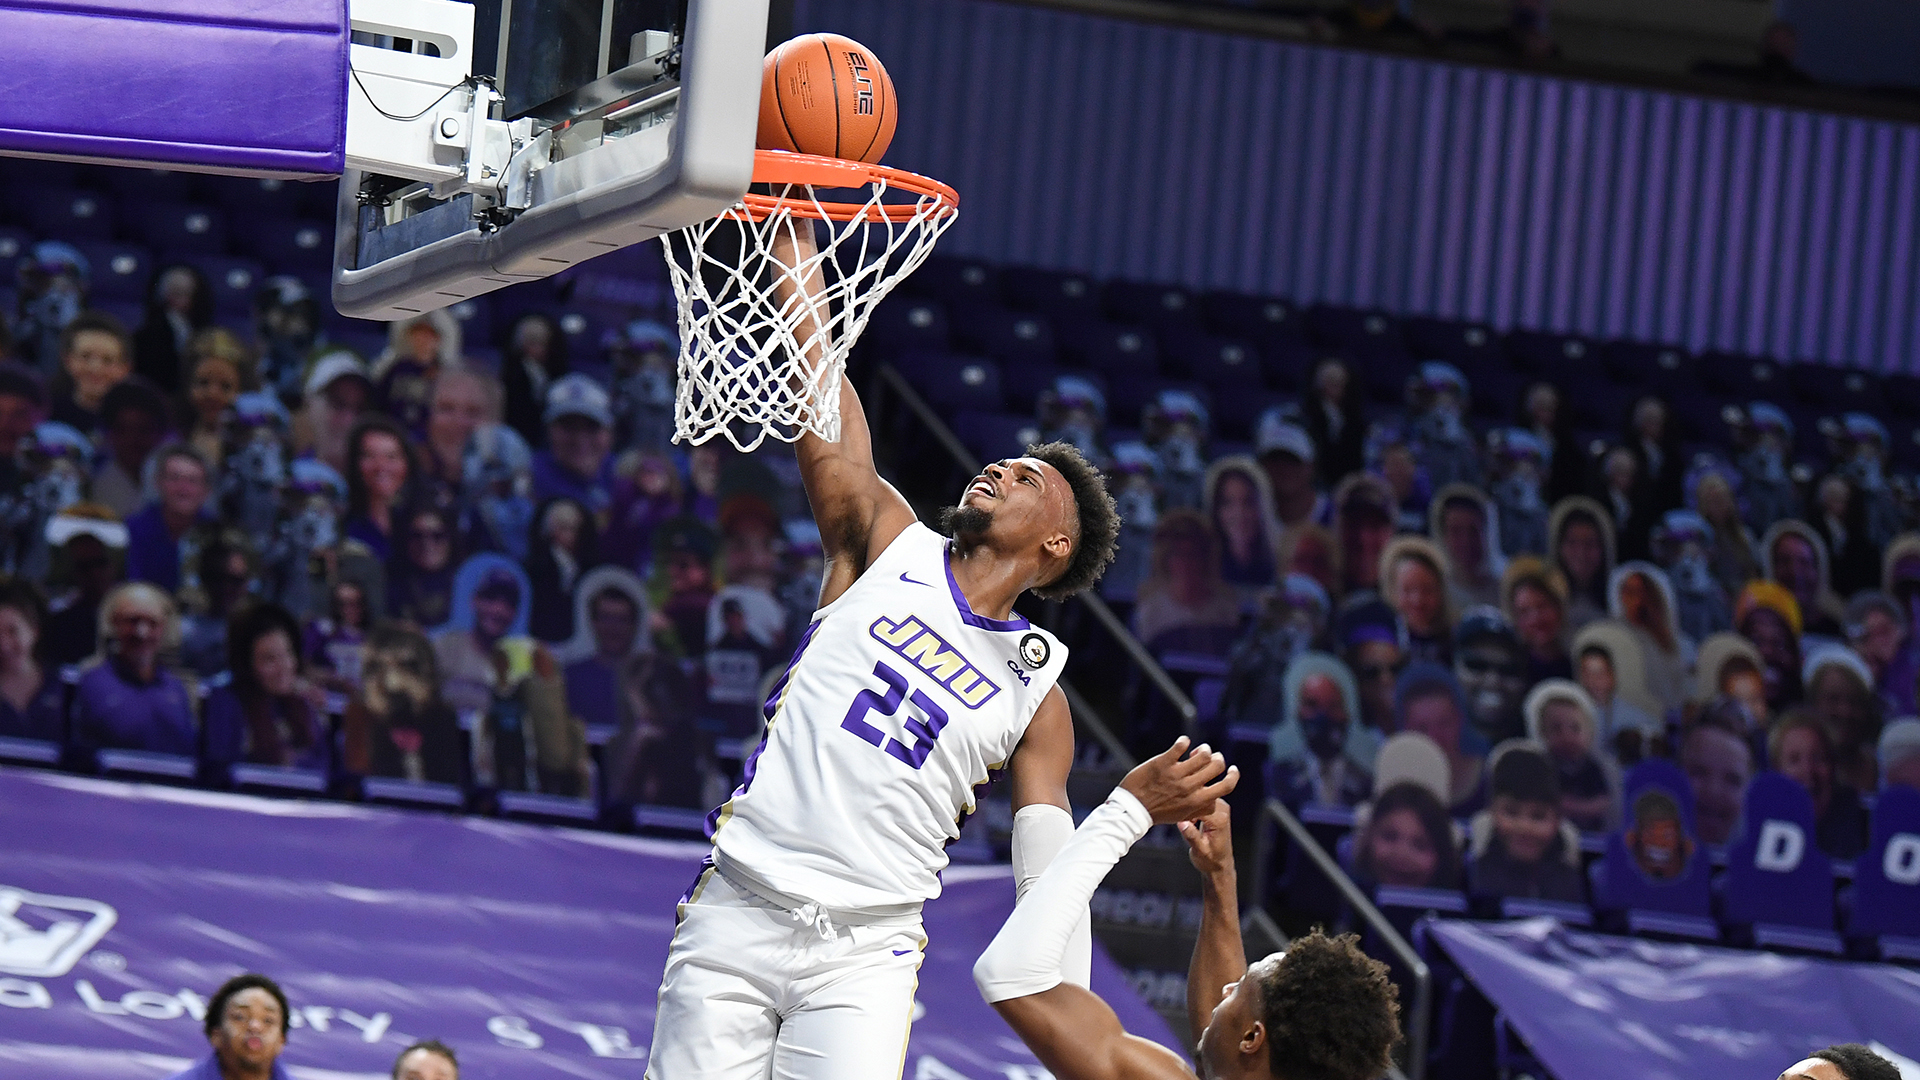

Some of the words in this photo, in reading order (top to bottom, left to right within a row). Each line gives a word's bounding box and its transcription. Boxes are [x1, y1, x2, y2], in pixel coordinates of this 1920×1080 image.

[848, 51, 874, 115] ELITE
[868, 613, 1003, 710] JMU
[1006, 659, 1032, 688] CAA
[840, 660, 949, 770] 23
[1755, 818, 1807, 873] D
[73, 978, 393, 1043] Lotry
